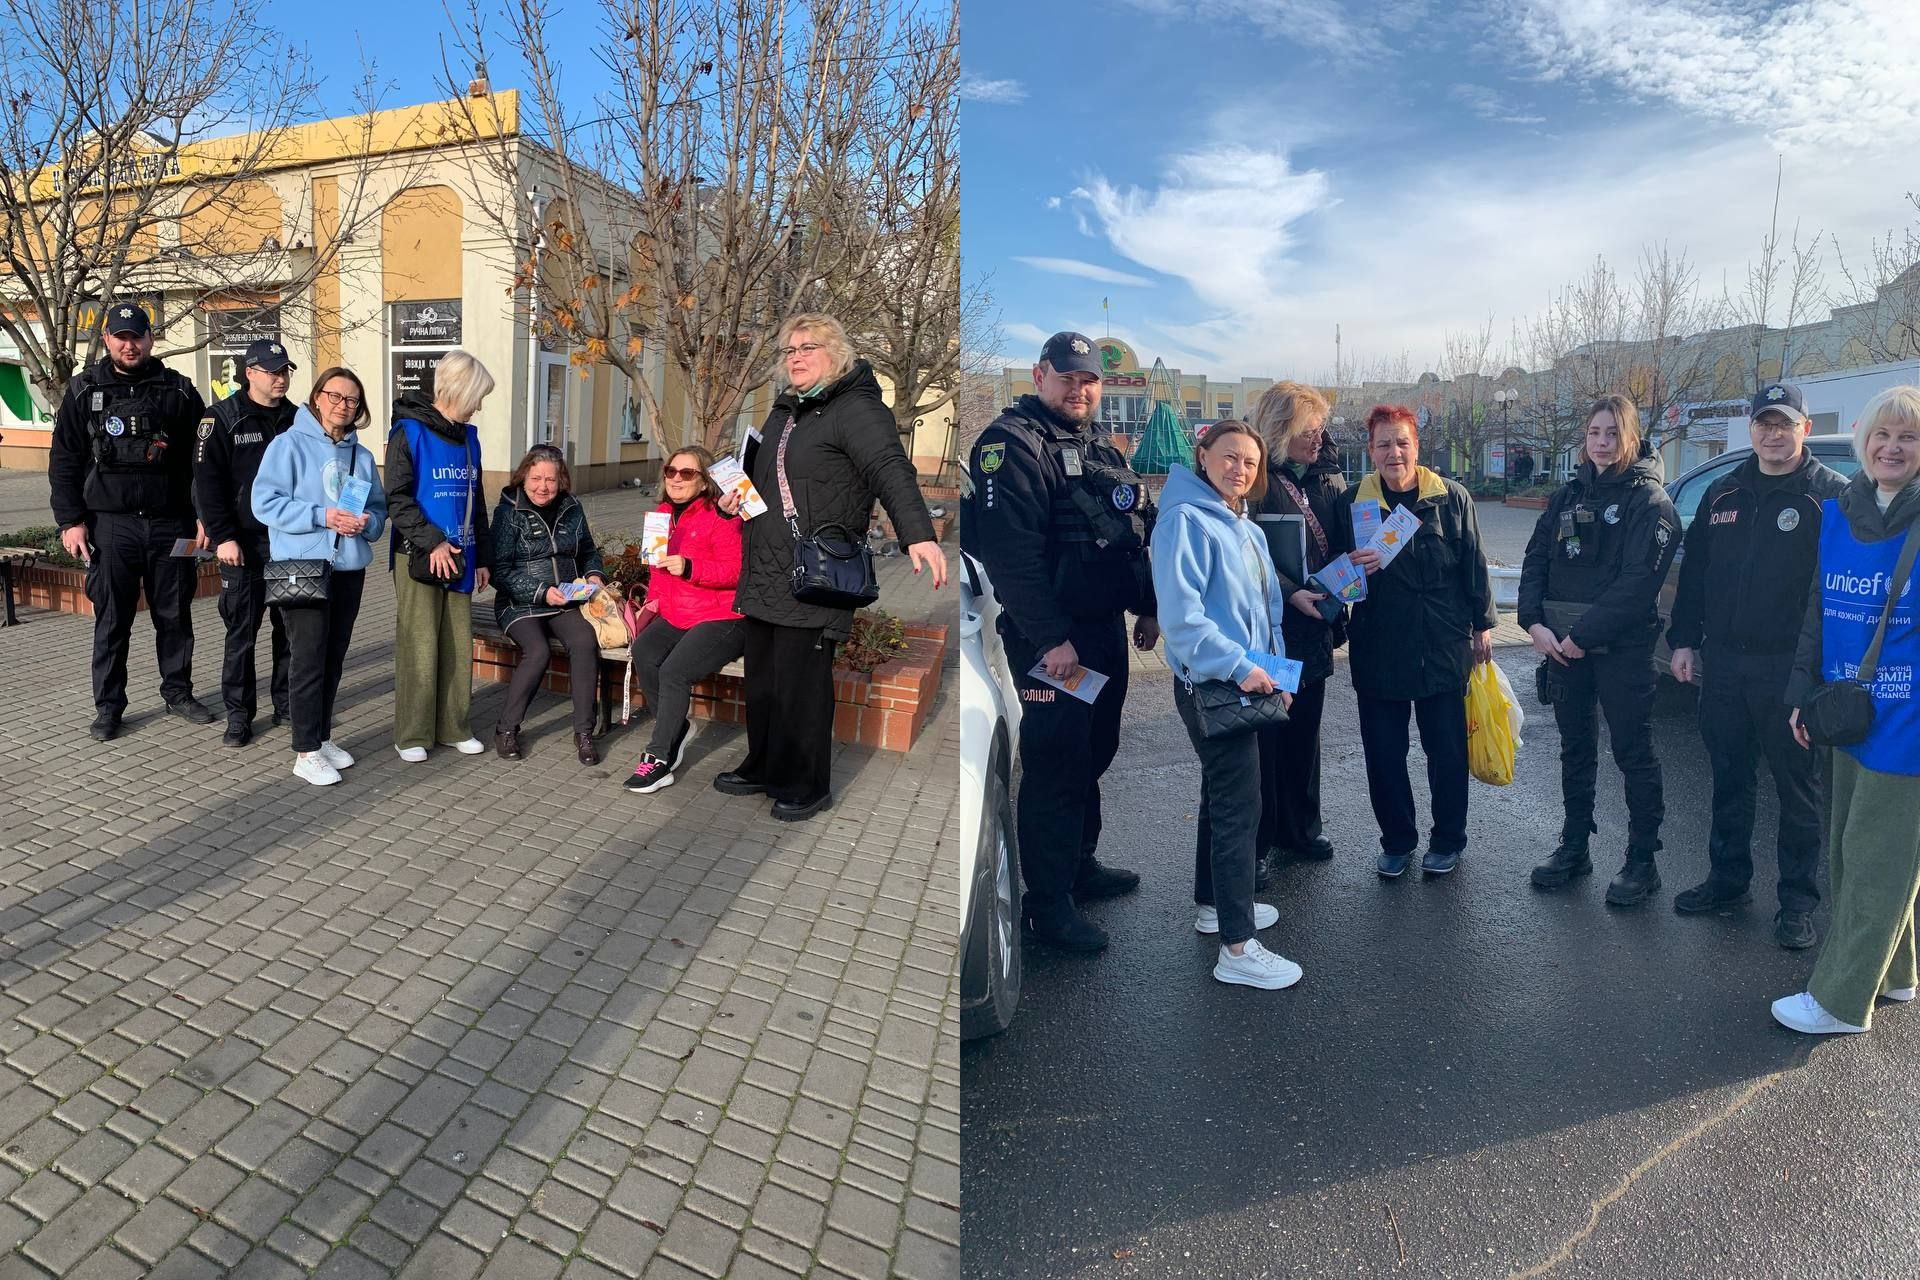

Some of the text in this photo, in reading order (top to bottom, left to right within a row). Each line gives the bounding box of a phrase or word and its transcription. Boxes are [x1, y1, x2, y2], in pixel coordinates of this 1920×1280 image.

[410, 326, 447, 336] РУЧНА ЛІПКА
[1826, 570, 1883, 596] unicef
[1866, 615, 1911, 625] диини
[1876, 671, 1912, 682] ЗМІН
[1880, 683, 1911, 692] FUND
[1876, 691, 1911, 699] CHANGE
